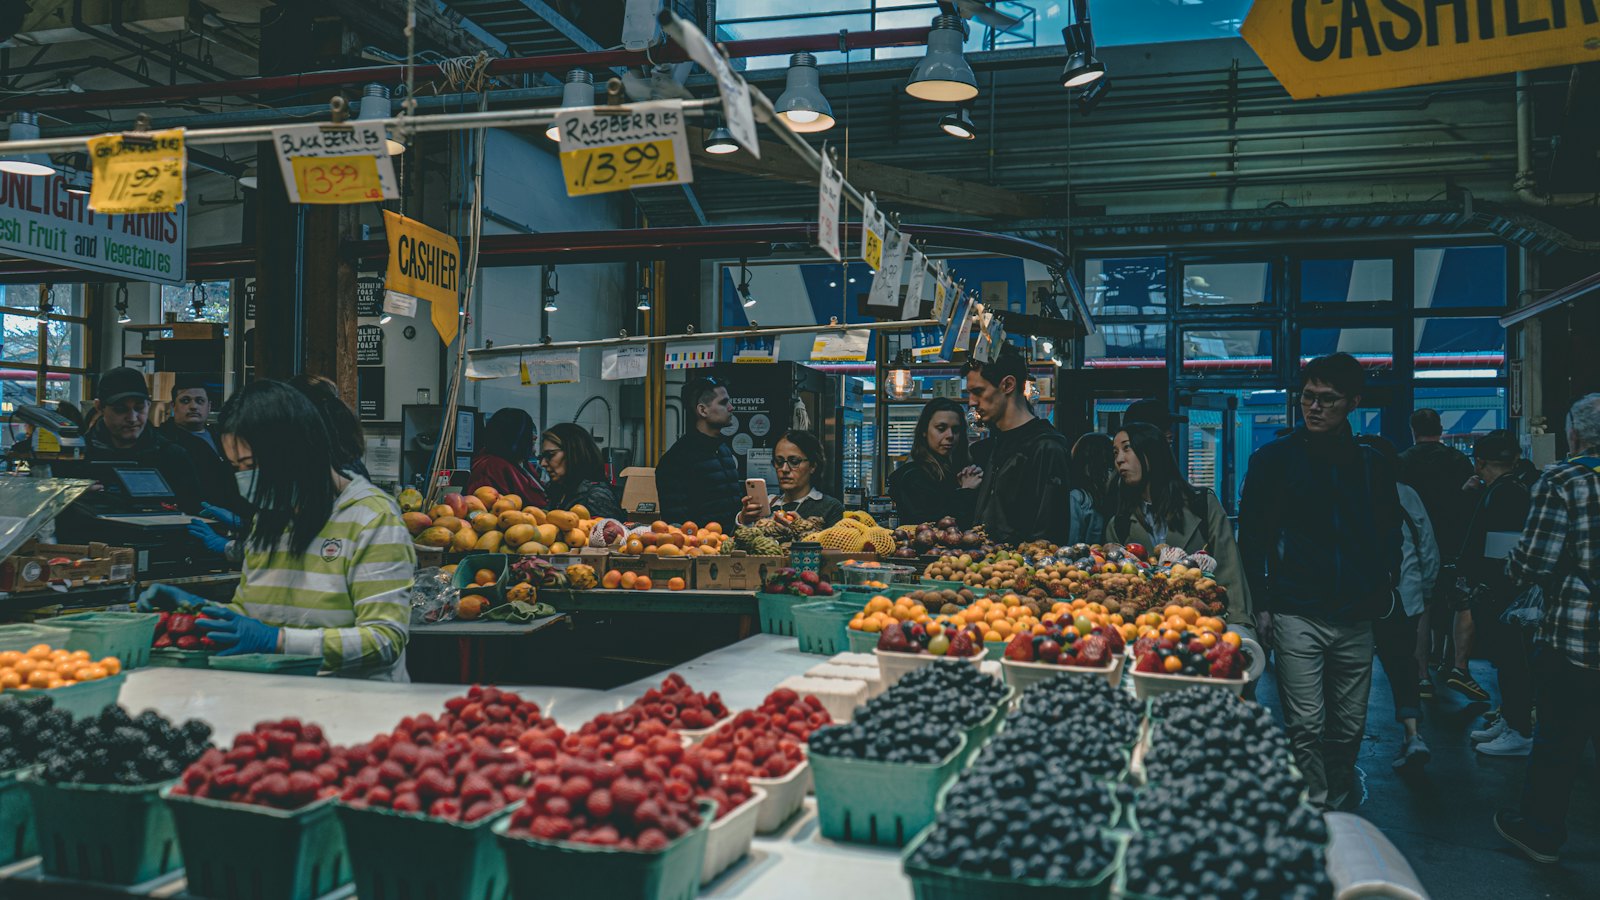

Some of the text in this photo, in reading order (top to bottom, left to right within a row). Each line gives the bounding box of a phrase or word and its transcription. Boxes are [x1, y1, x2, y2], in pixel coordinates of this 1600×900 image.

[280, 129, 380, 154] BLACKBERRIES
[565, 111, 679, 143] RASPBERRIES
[108, 166, 160, 201] 11.99
[302, 164, 359, 197] 13.99
[656, 162, 675, 180] LB
[29, 220, 68, 253] Fruit
[74, 235, 97, 258] and
[104, 236, 171, 274] Vegetables
[398, 234, 457, 292] CASHIER
